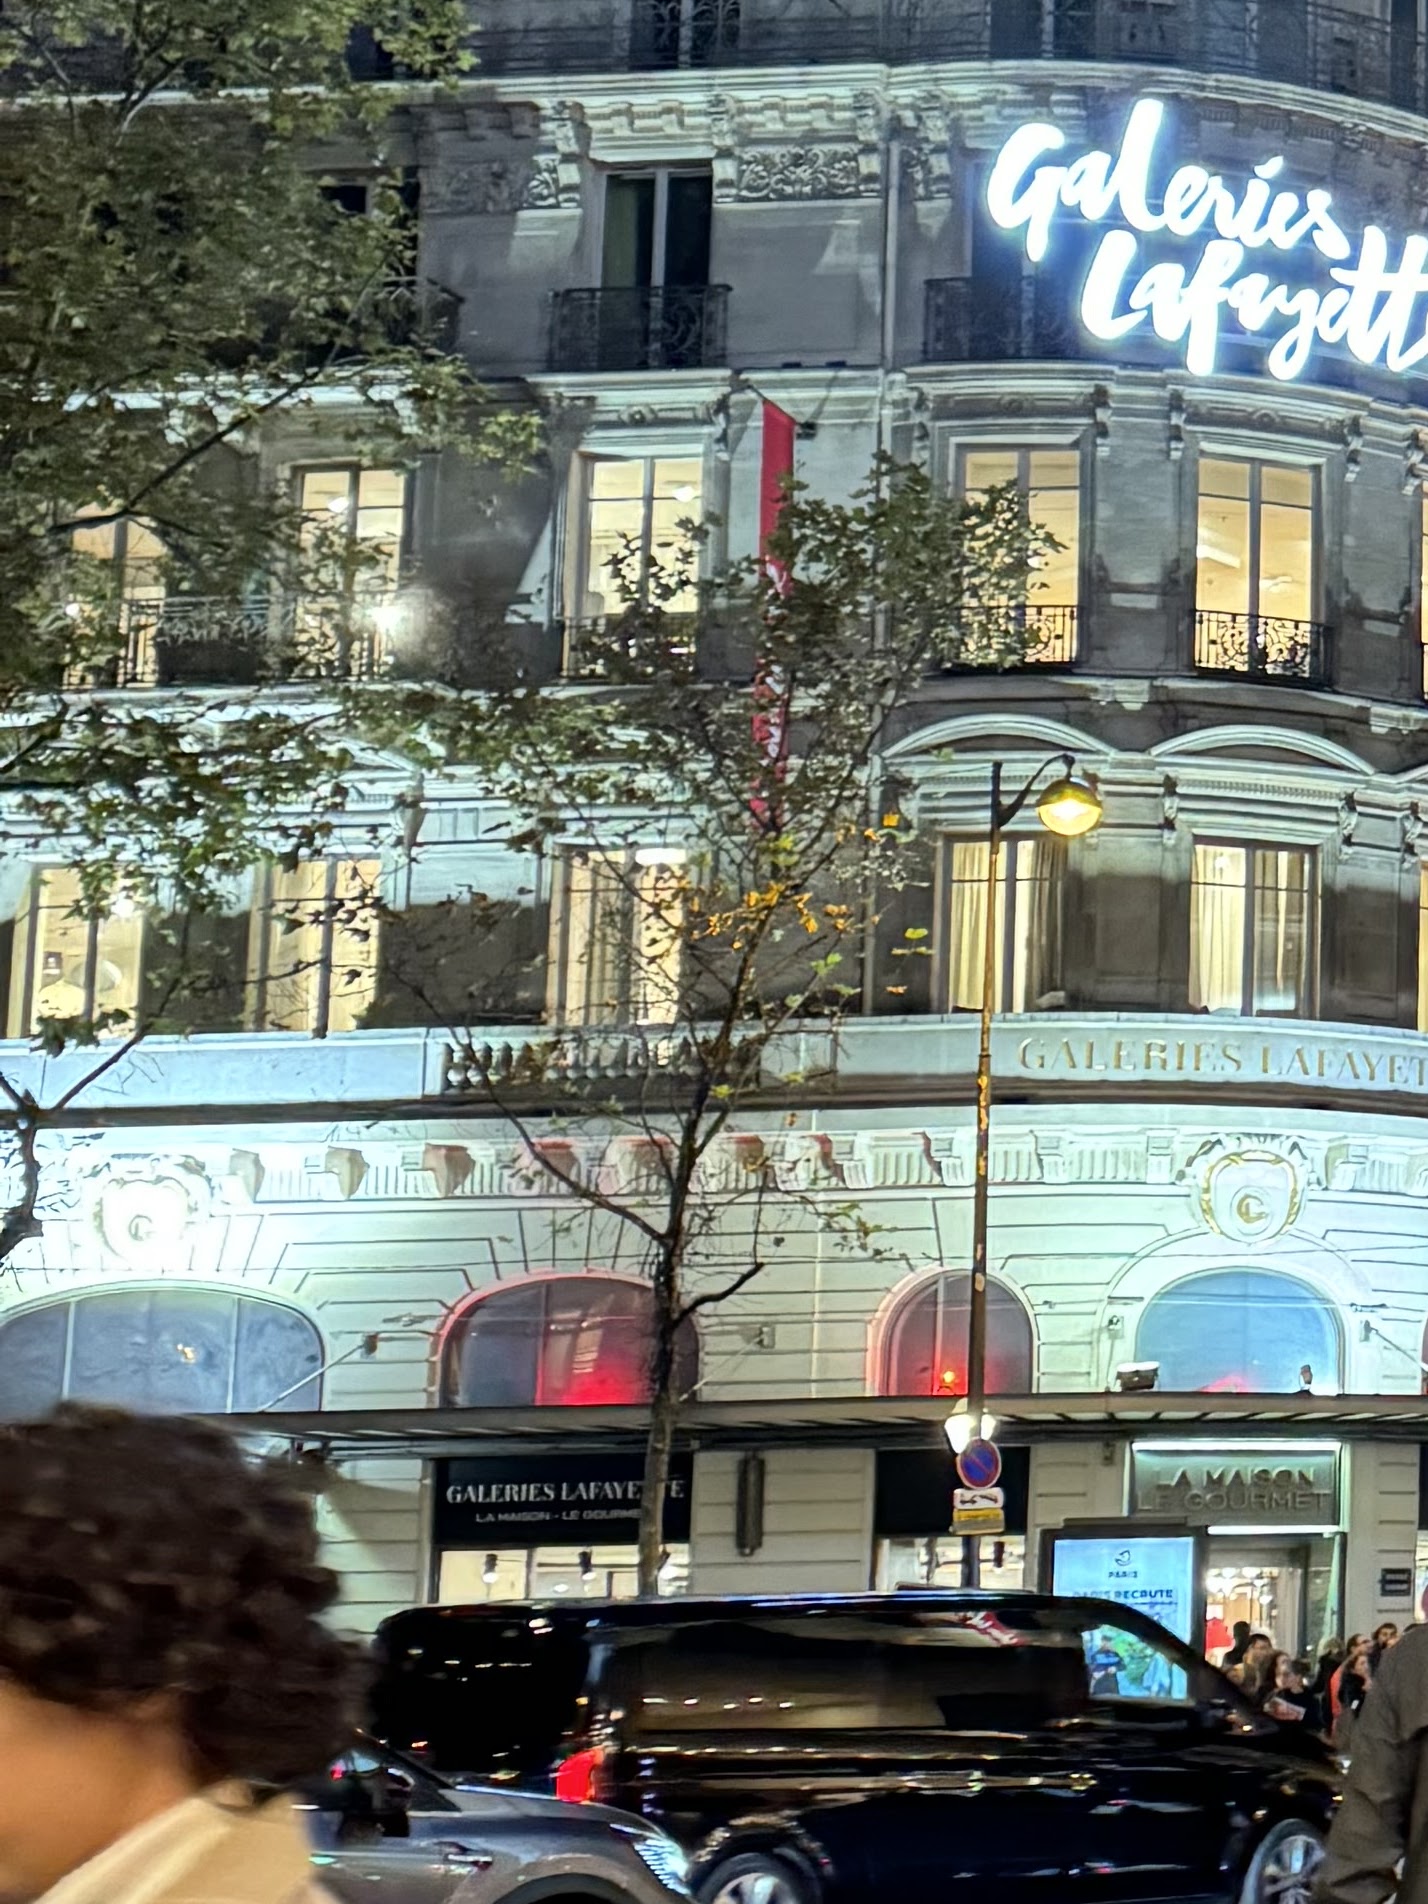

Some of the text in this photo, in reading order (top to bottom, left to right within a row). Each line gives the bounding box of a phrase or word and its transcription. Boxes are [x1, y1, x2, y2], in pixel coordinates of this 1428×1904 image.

[987, 99, 1350, 262] Galeries
[1019, 1038, 1242, 1071] GALERIES
[1155, 1466, 1314, 1490] LA MAISON
[446, 1480, 686, 1503] GALERIES LAFAYEE
[1184, 1490, 1331, 1511] GOURMET
[582, 1508, 643, 1520] GOURME
